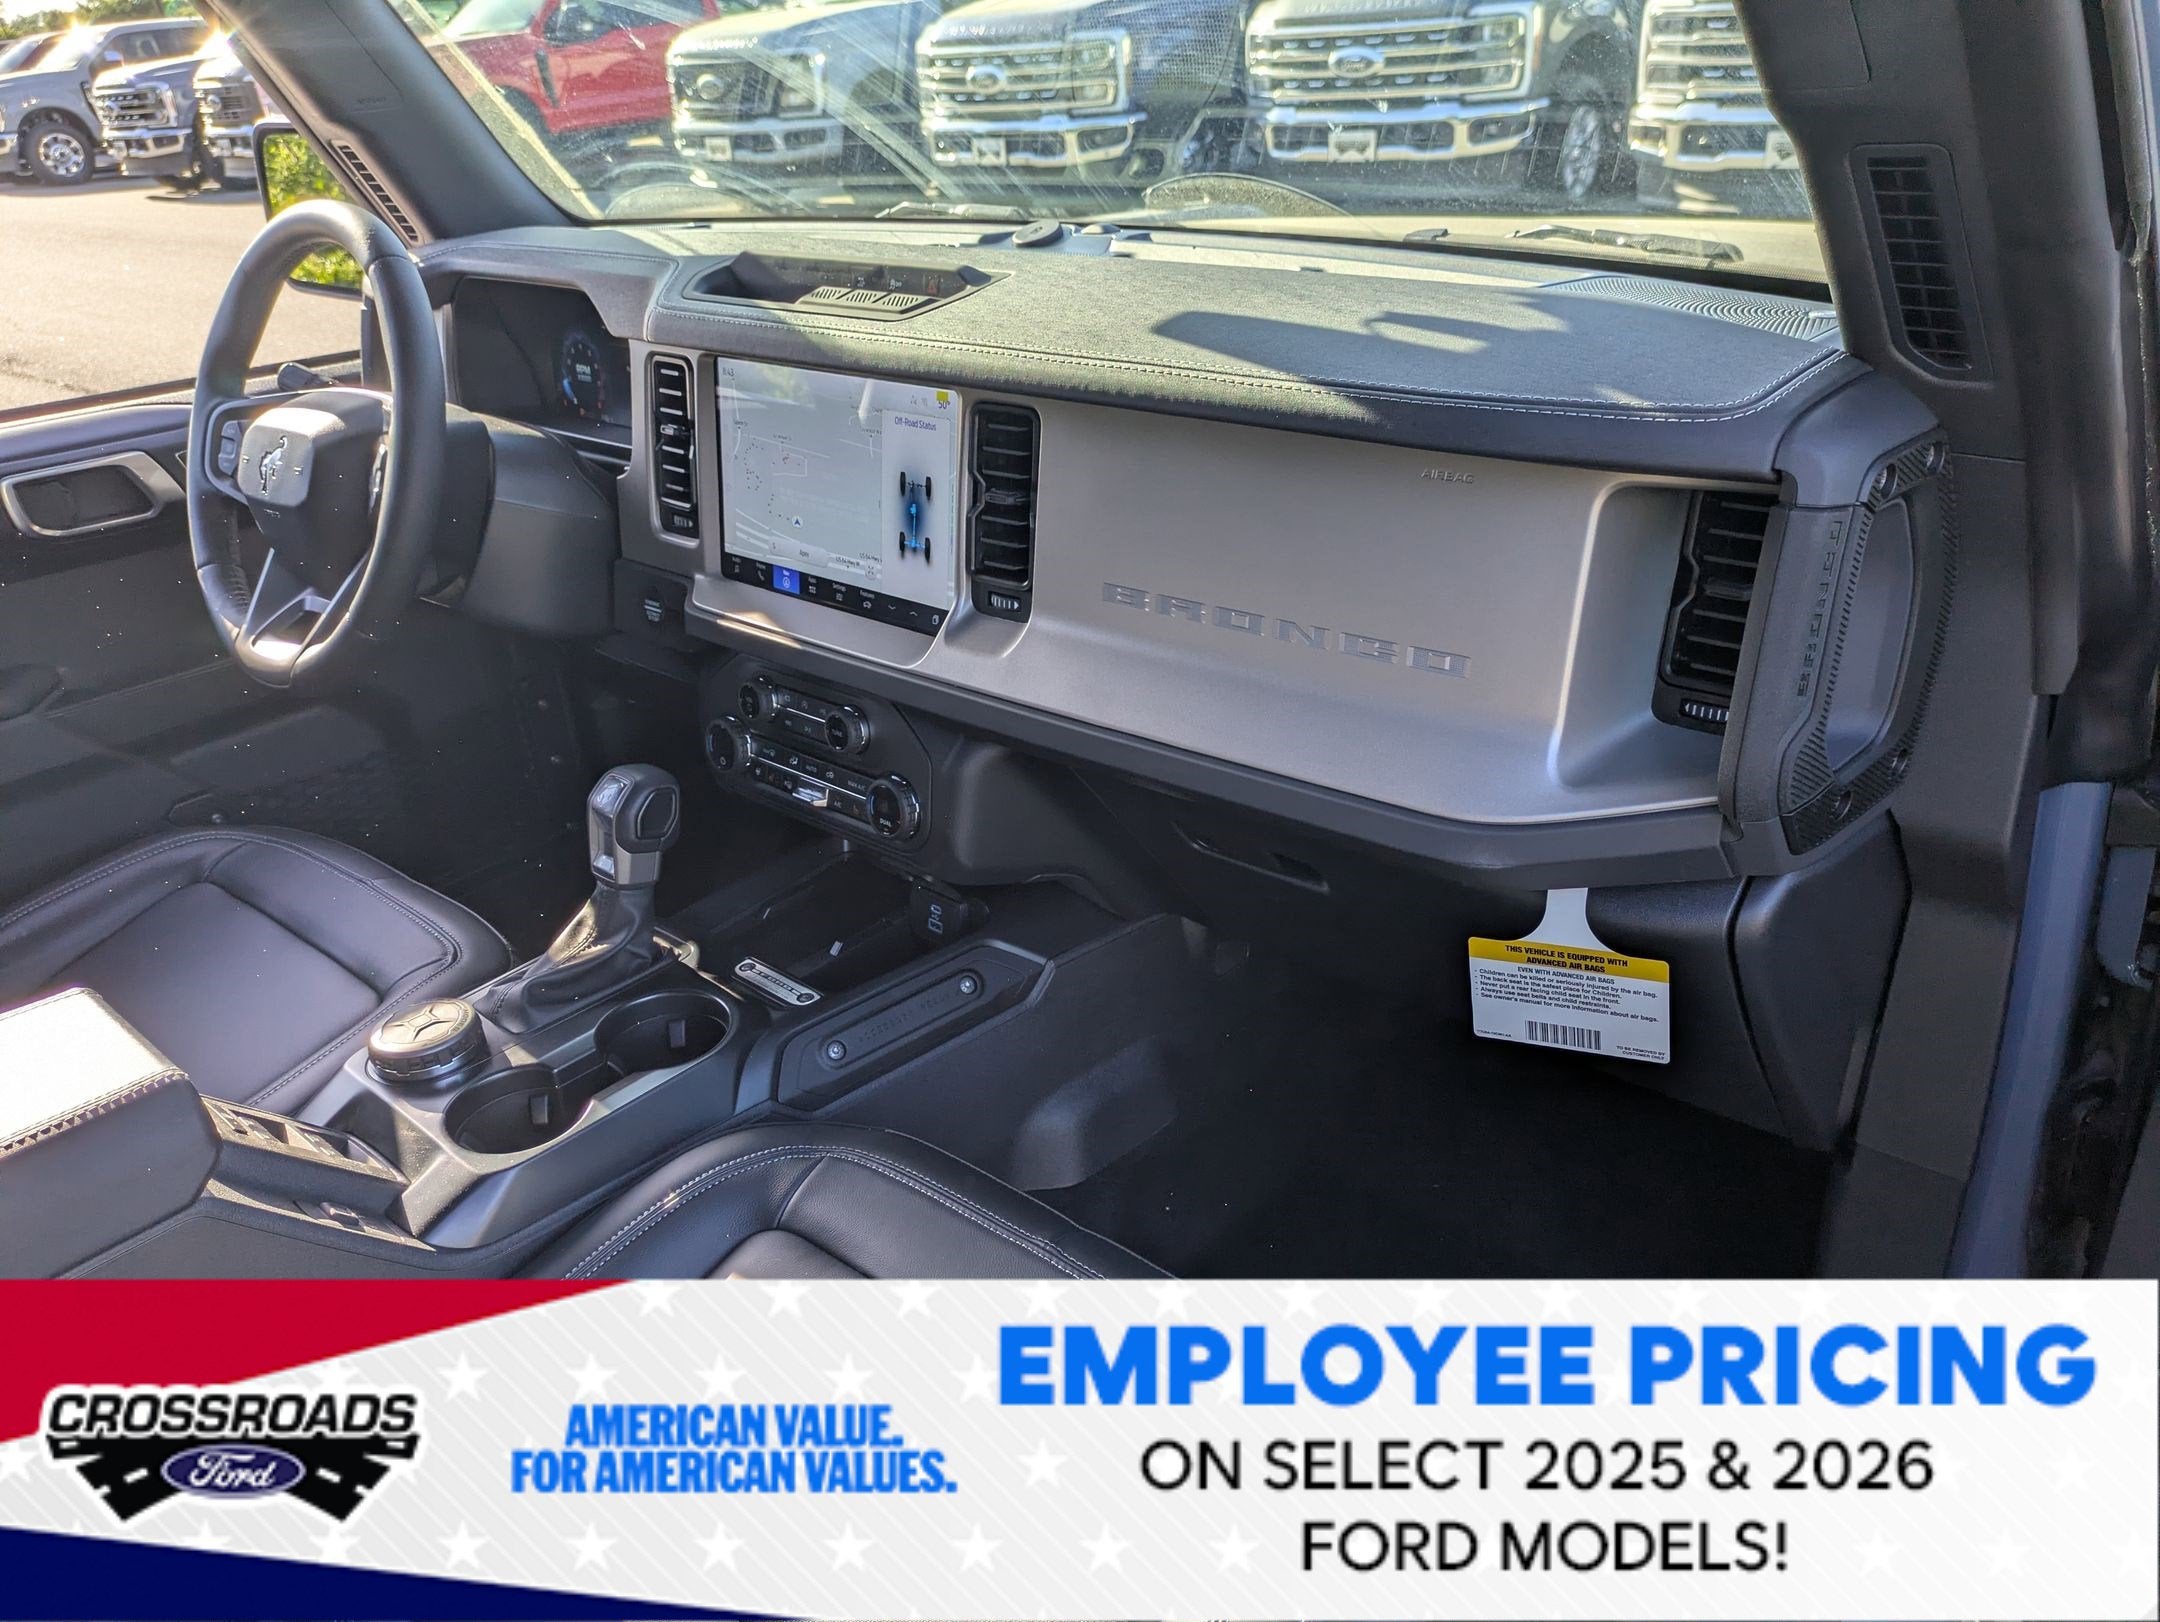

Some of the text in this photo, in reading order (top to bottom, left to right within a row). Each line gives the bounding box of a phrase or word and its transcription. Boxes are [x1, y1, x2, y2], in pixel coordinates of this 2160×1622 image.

[894, 416, 937, 431] Off-Road Status
[1420, 469, 1473, 484] AIRBAG
[1102, 582, 1472, 679] BRONCO
[1505, 945, 1522, 953] THIS
[1524, 947, 1556, 958] VEHICLE
[1568, 952, 1605, 964] EQUIPPED
[1608, 958, 1628, 966] WITH
[1526, 956, 1606, 973] ADVANCED AIR BAGS
[1480, 968, 1506, 976] Children
[1556, 978, 1584, 988] seriously
[1586, 982, 1609, 991] injured
[1610, 984, 1618, 992] by
[1552, 970, 1584, 980] ADVANCED
[1480, 986, 1502, 994] Always
[1530, 987, 1550, 995] facing
[1563, 985, 1580, 993] place
[1572, 1004, 1608, 1015] information
[1610, 1010, 1630, 1018] about
